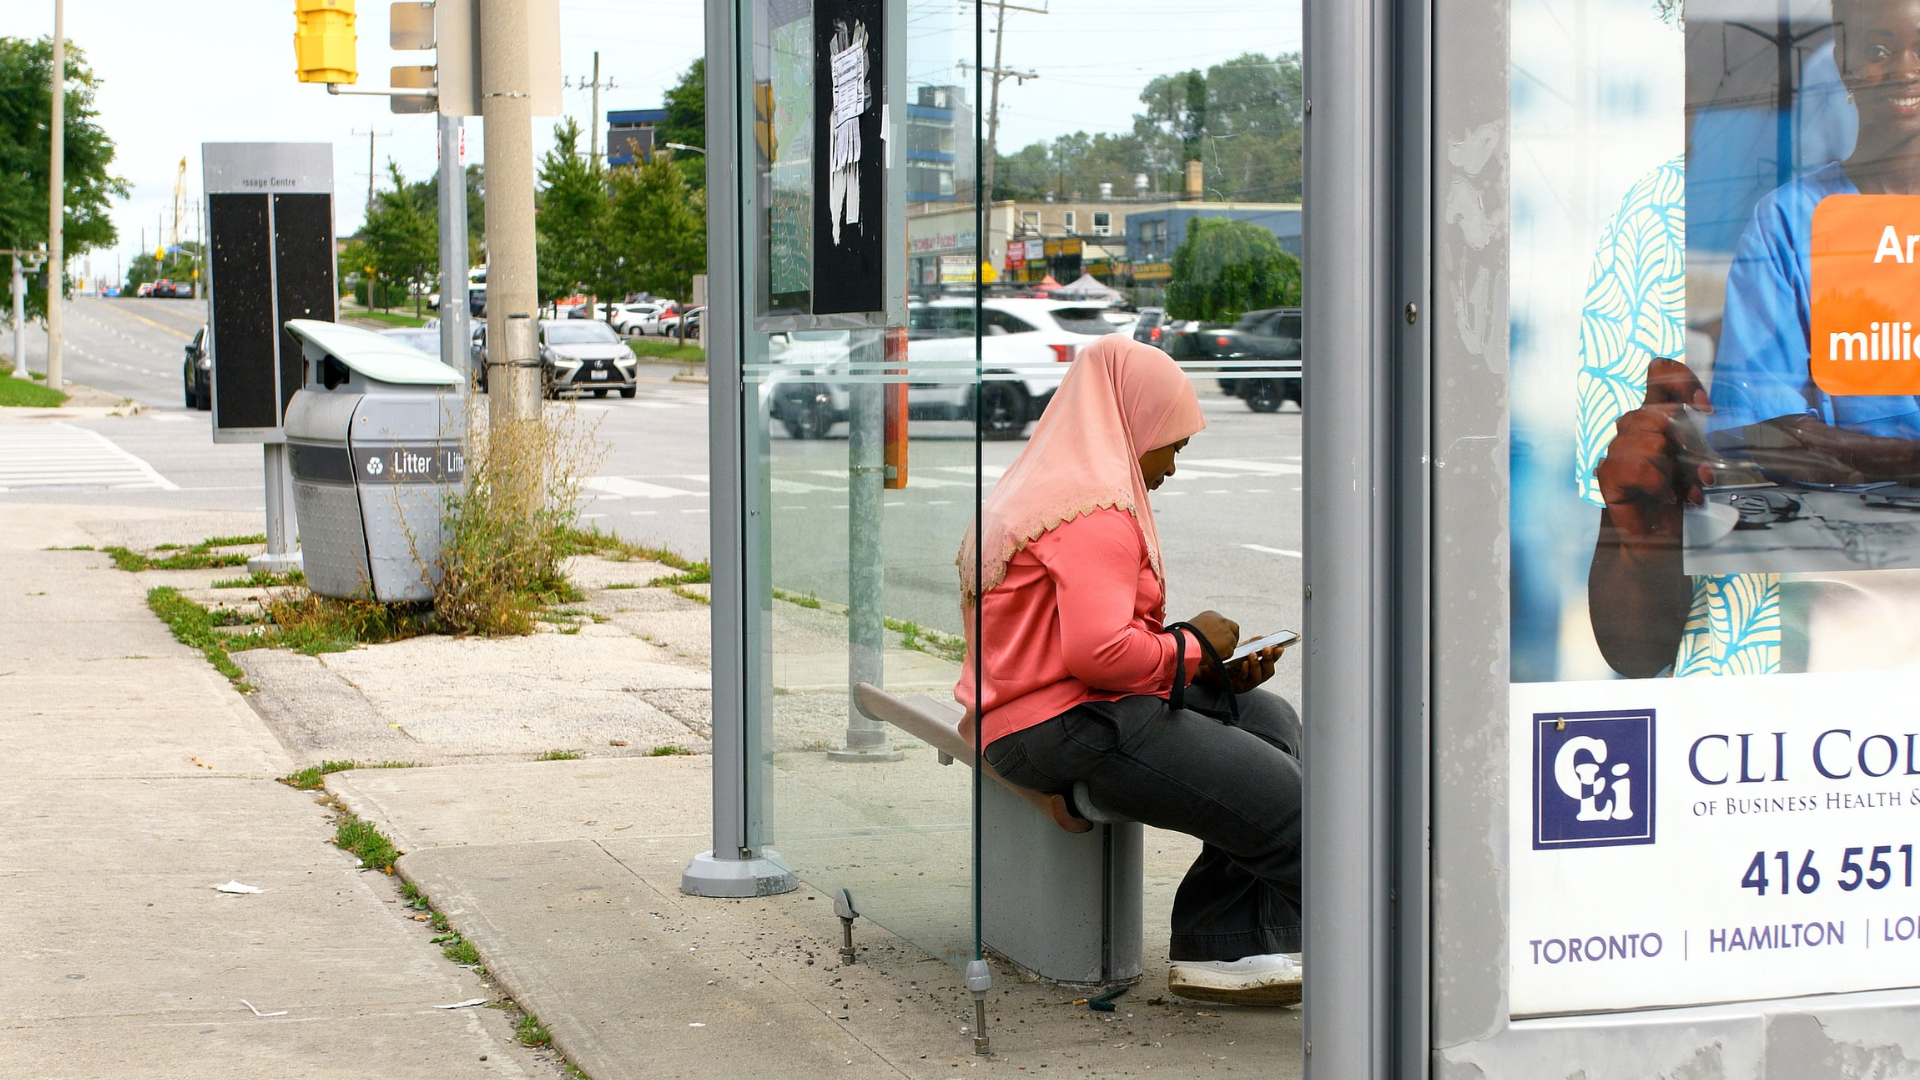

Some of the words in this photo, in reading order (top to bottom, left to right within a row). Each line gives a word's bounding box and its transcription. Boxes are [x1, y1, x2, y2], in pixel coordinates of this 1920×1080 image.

[270, 177, 296, 187] Centre
[1873, 225, 1920, 264] Ar
[394, 451, 432, 474] Litter
[1688, 731, 1789, 786] CLI
[1692, 800, 1717, 817] OF
[1726, 795, 1818, 815] BUSINESS
[1825, 791, 1902, 810] HEALTH
[1741, 848, 1821, 897] 416
[1837, 843, 1914, 892] 551
[1529, 932, 1663, 965] TORONTO
[1710, 920, 1845, 953] HAMILTON
[1884, 915, 1920, 942] LO
